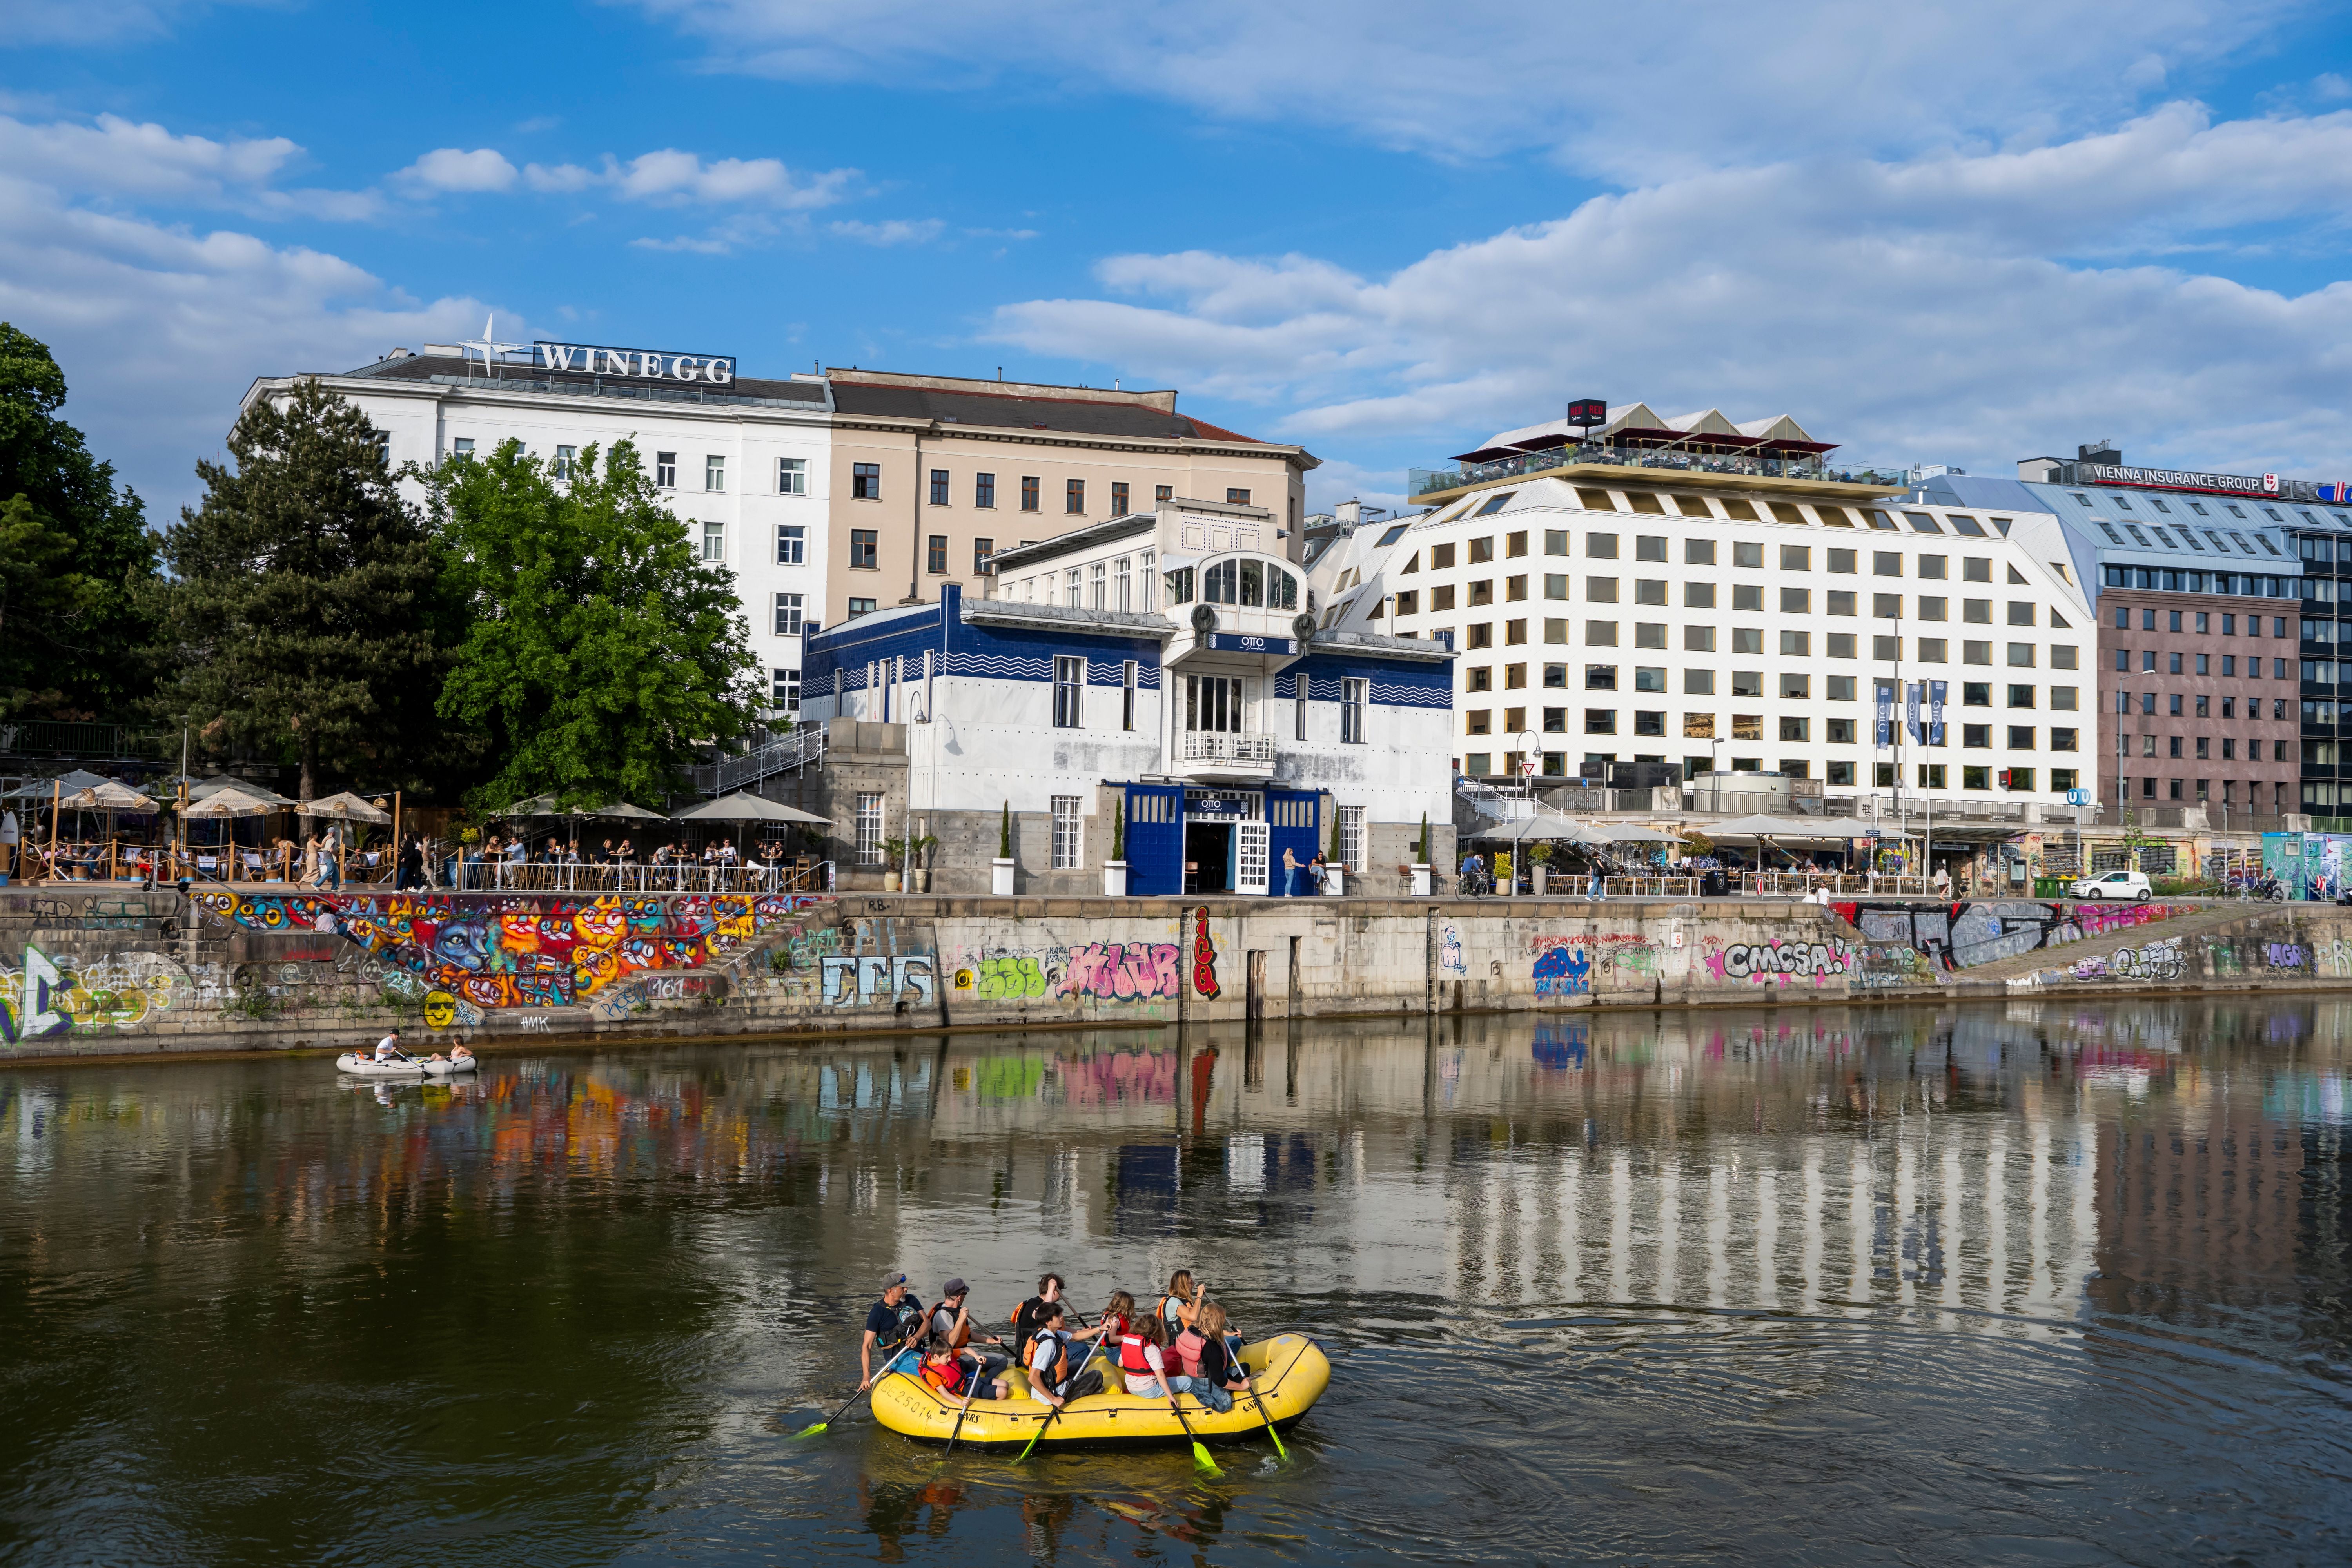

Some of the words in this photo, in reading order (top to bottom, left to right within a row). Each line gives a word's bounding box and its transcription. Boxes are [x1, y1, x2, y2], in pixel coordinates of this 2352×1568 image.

[539, 344, 733, 384] WINEGG
[1570, 406, 1583, 416] RED
[1589, 405, 1603, 414] RED
[2094, 465, 2142, 481] VIENNA
[2144, 470, 2215, 486] INSURANCE
[2218, 476, 2259, 490] GROUP
[1241, 636, 1264, 646] OTTO
[2068, 791, 2077, 803] U
[2082, 791, 2089, 803] U
[1676, 935, 1681, 944] 5
[1525, 948, 1540, 956] WHY
[963, 1412, 980, 1423] NRS
